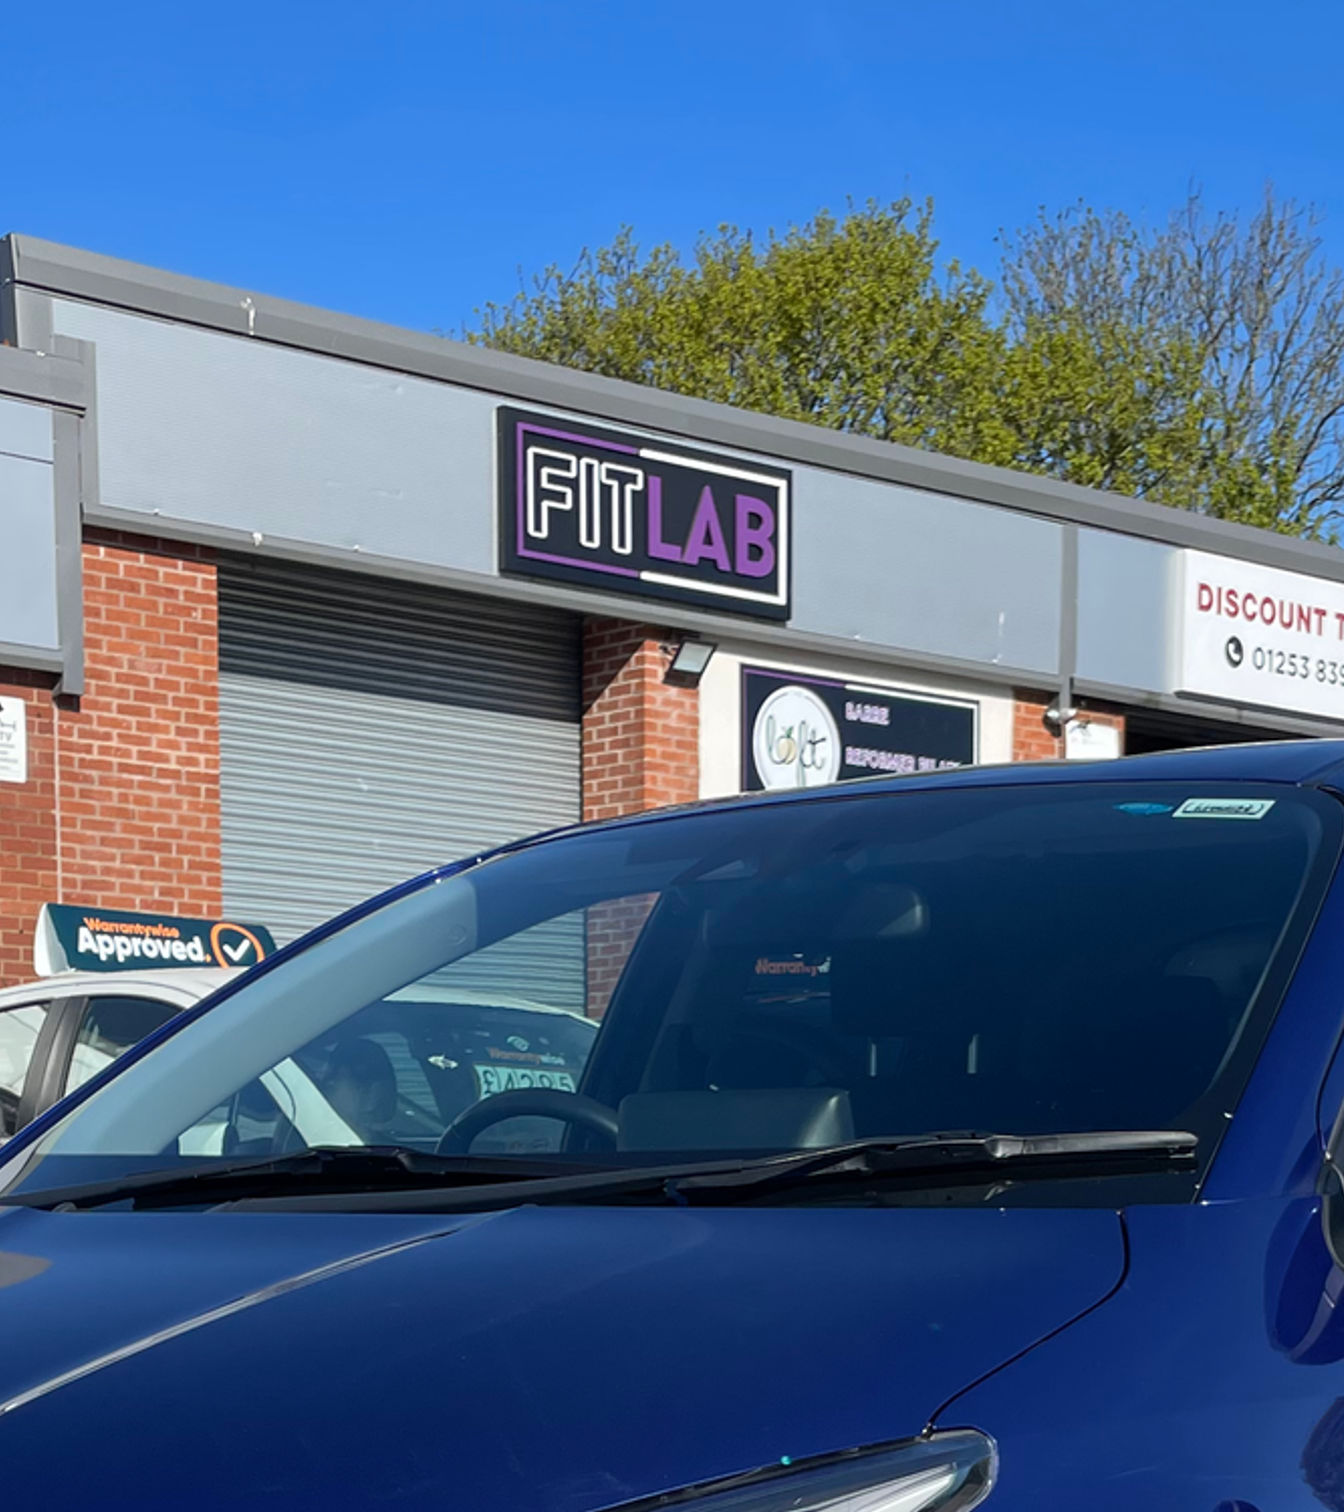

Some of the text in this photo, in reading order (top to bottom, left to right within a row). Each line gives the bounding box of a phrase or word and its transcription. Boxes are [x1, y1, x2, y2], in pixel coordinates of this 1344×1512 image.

[1197, 583, 1327, 637] DISCOUNT
[1252, 647, 1310, 679] 01253
[83, 917, 180, 938] Warrantywise
